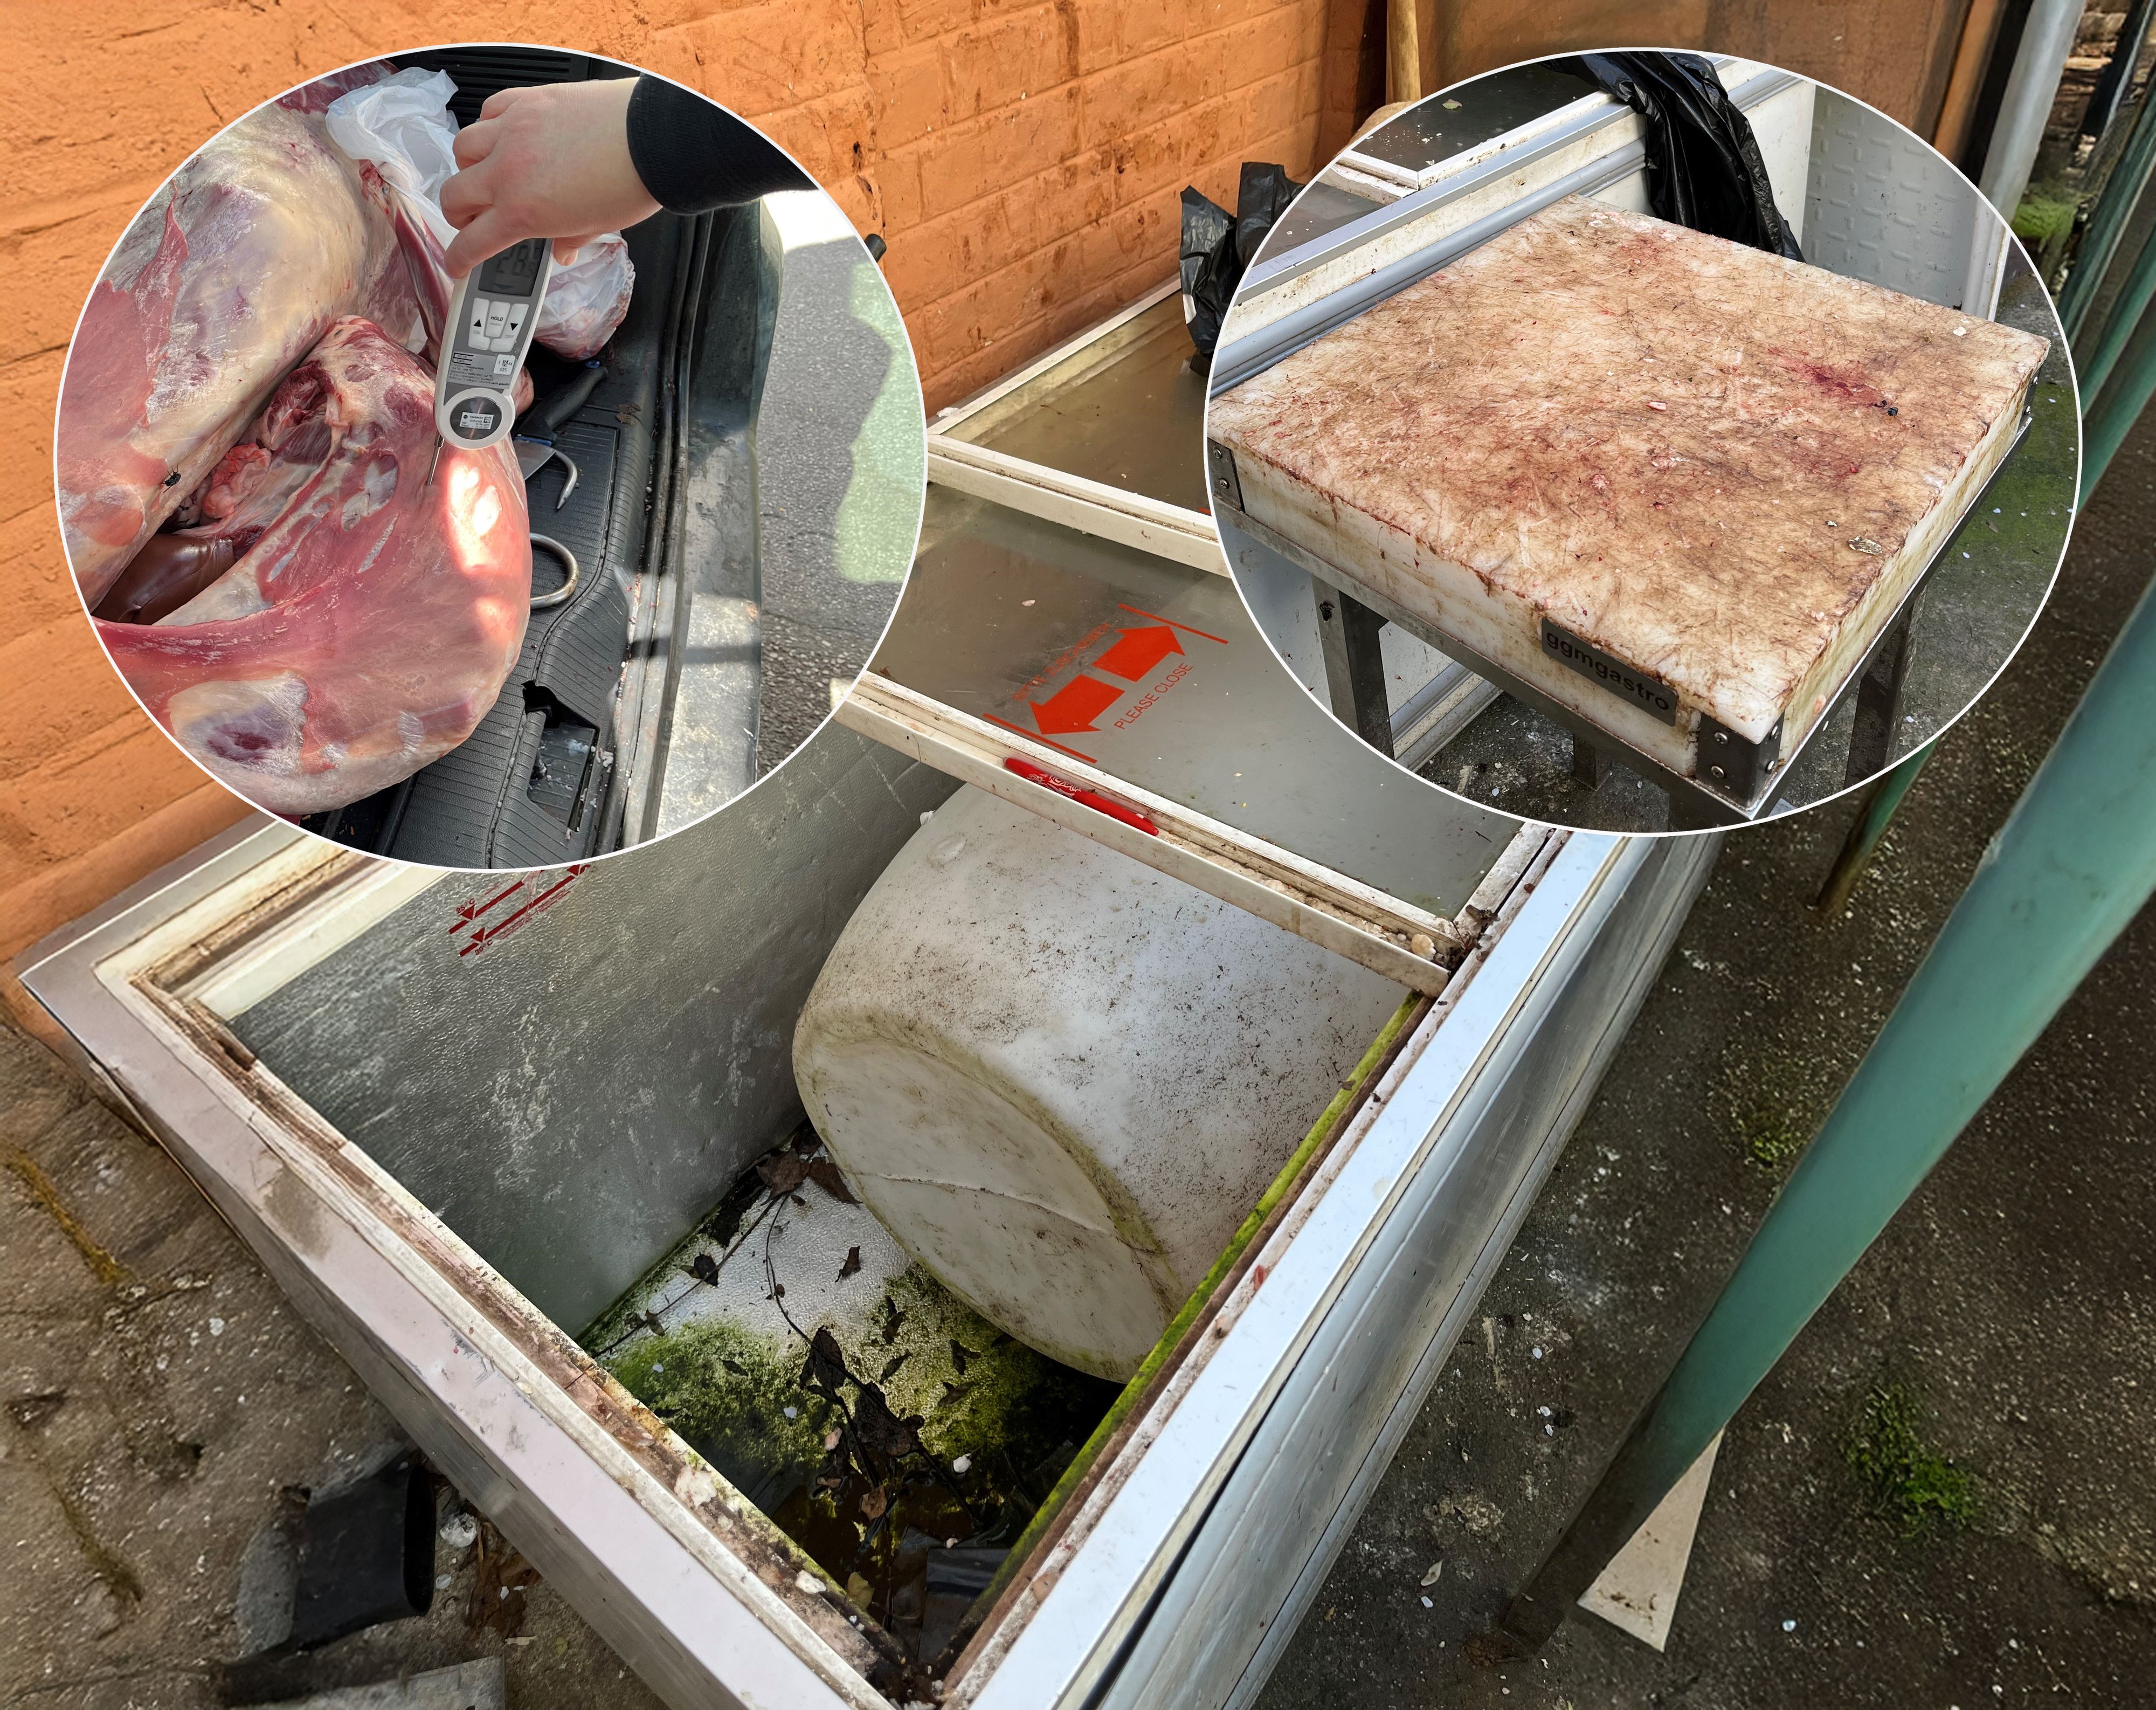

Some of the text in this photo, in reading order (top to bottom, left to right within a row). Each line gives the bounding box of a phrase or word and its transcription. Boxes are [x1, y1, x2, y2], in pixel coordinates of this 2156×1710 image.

[1114, 662, 1193, 729] PLEASE CLOSE
[1545, 632, 1670, 711] ggmgastro
